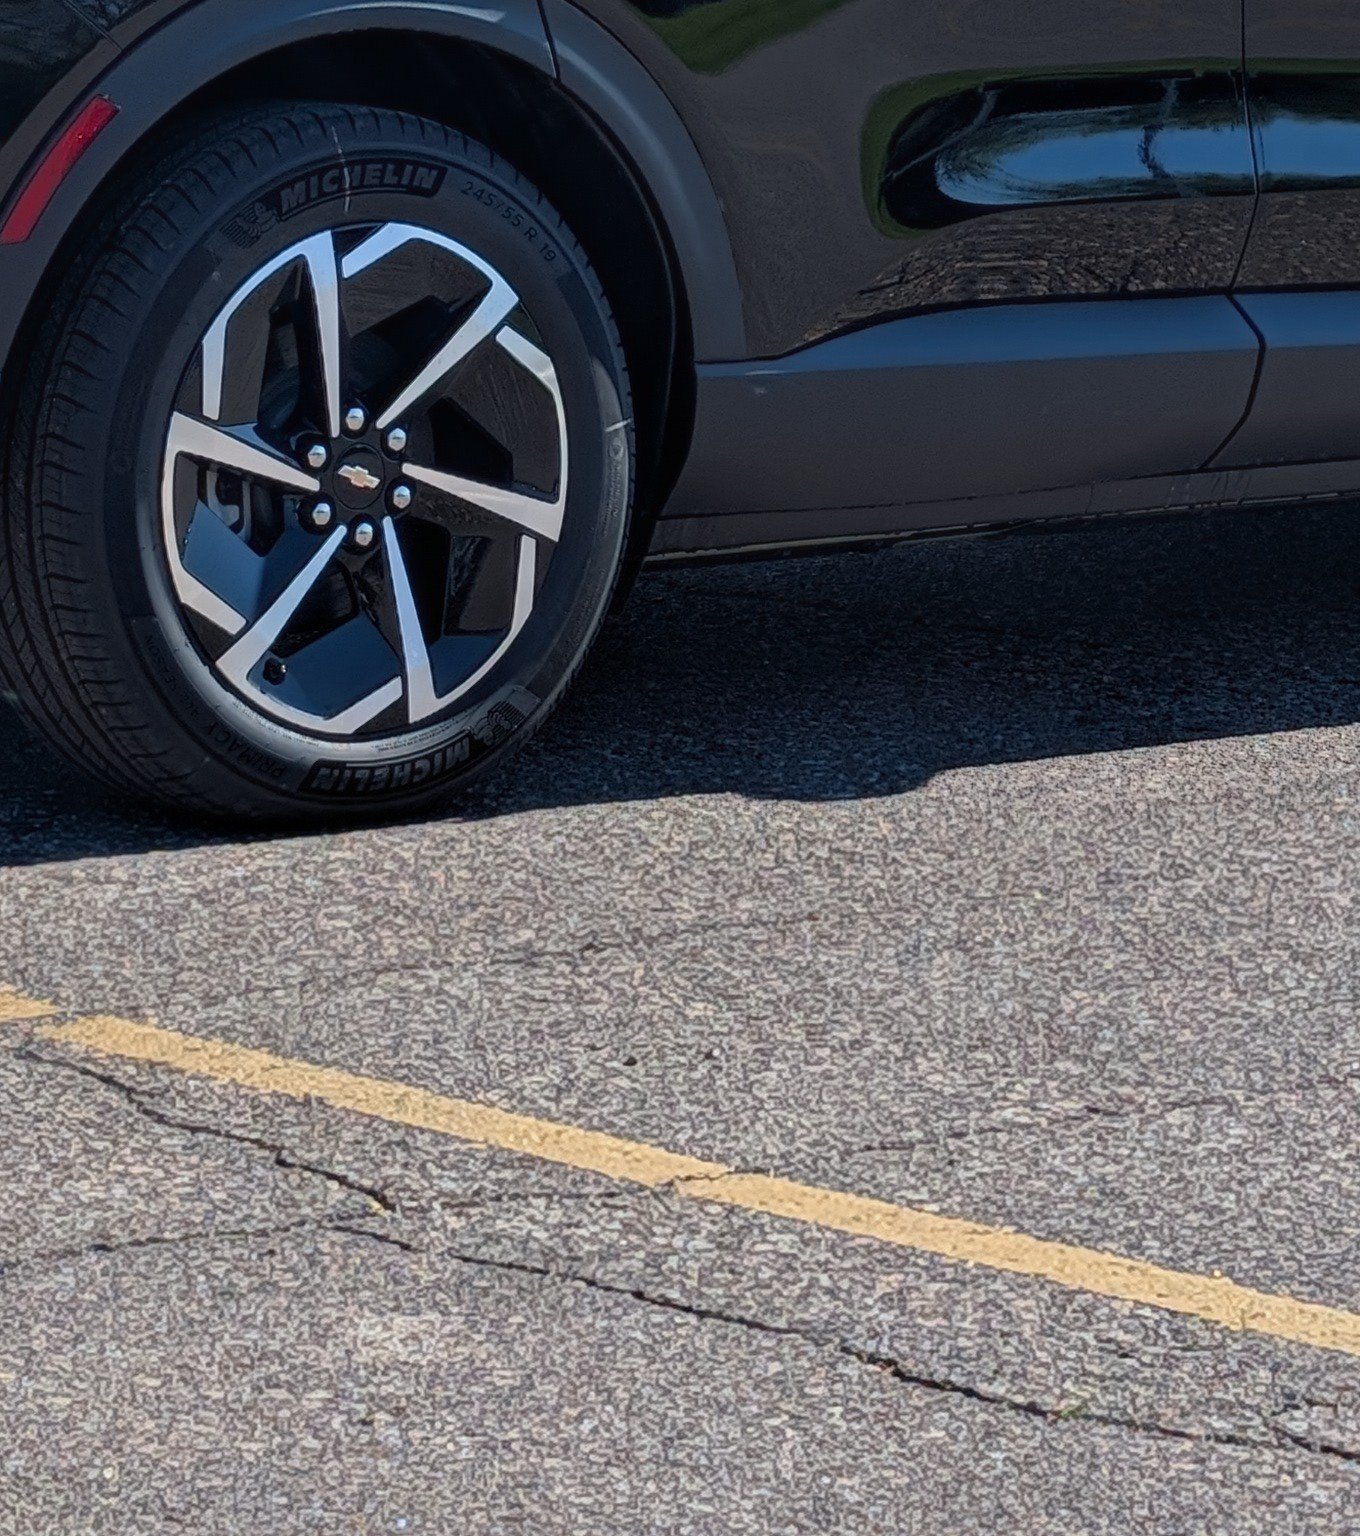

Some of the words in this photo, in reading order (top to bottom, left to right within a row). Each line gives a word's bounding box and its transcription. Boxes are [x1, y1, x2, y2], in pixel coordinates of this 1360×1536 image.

[280, 165, 439, 215] MICHELIN
[460, 180, 522, 228] 245/55
[523, 227, 539, 244] R
[539, 242, 557, 263] 19
[205, 721, 286, 779] PRIMACY
[311, 736, 471, 792] MICHELIN
